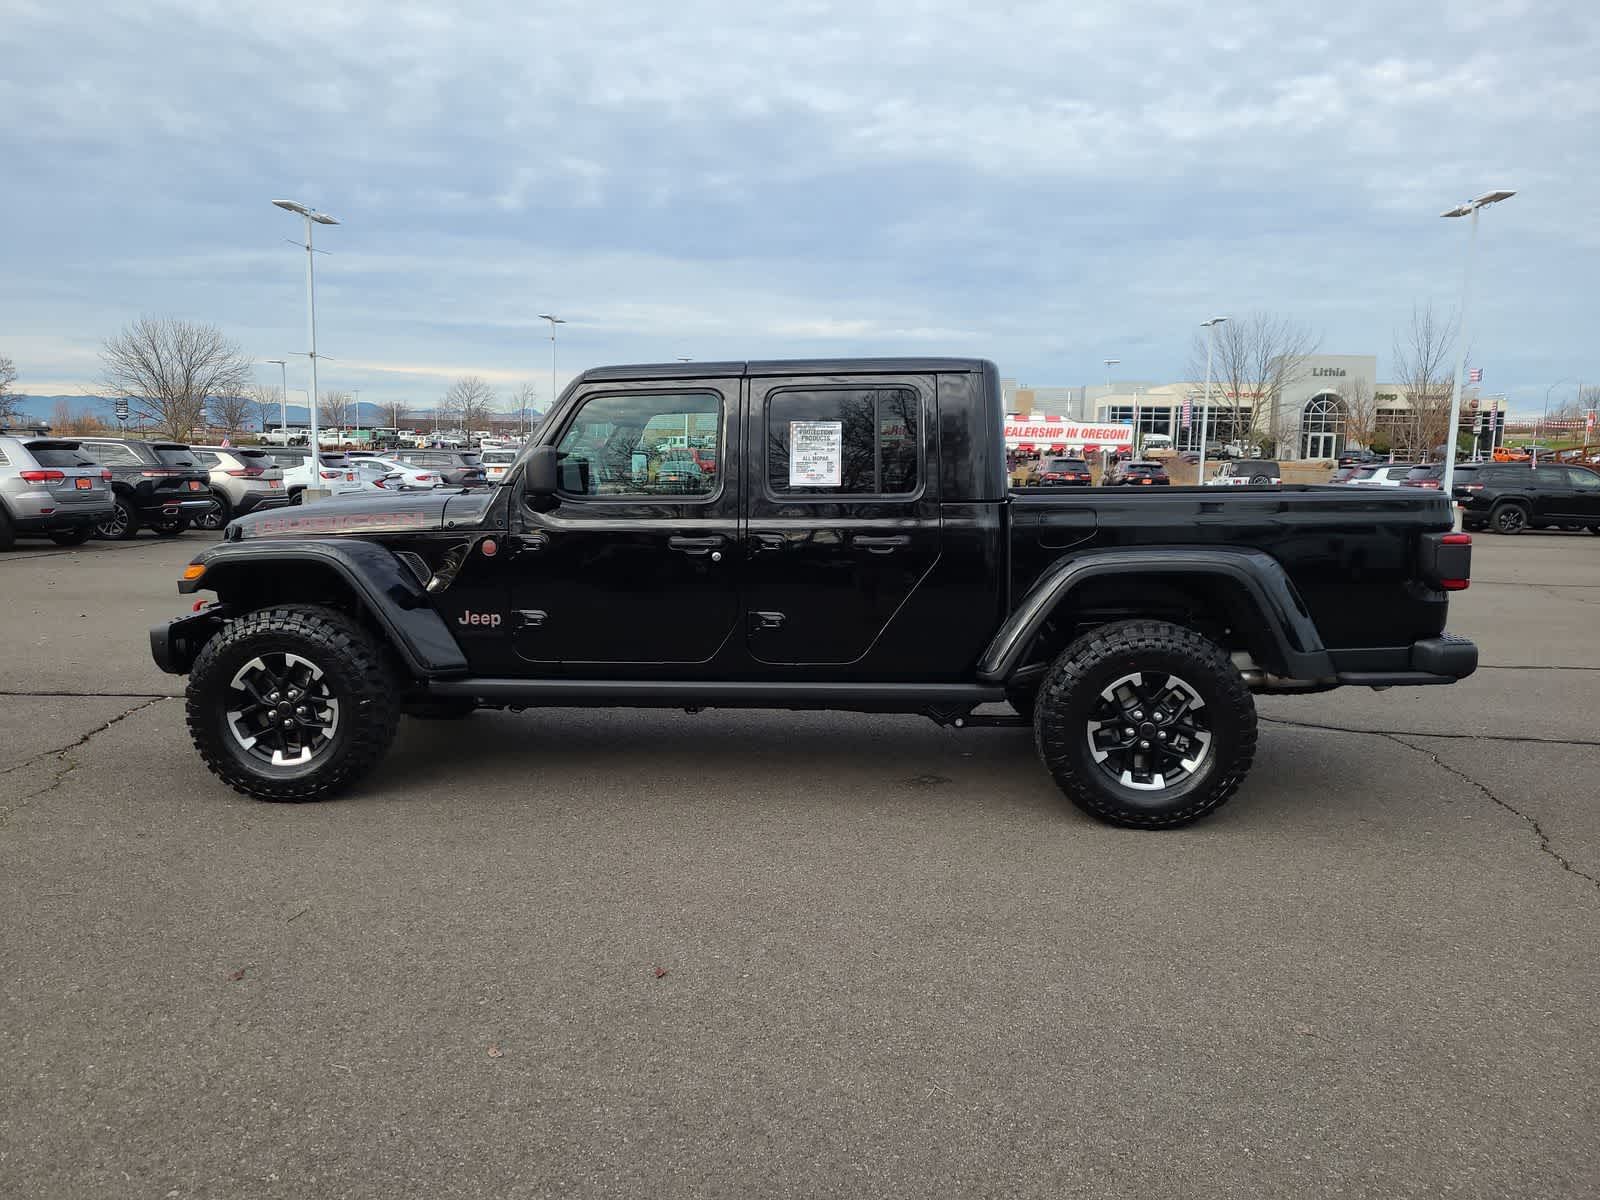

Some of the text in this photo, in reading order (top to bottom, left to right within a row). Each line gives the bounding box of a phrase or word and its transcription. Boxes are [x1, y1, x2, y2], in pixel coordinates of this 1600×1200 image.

[1312, 367, 1346, 377] Lithia
[1004, 426, 1130, 440] EALERSHIP IN OREGON!
[458, 610, 502, 629] Jeep
